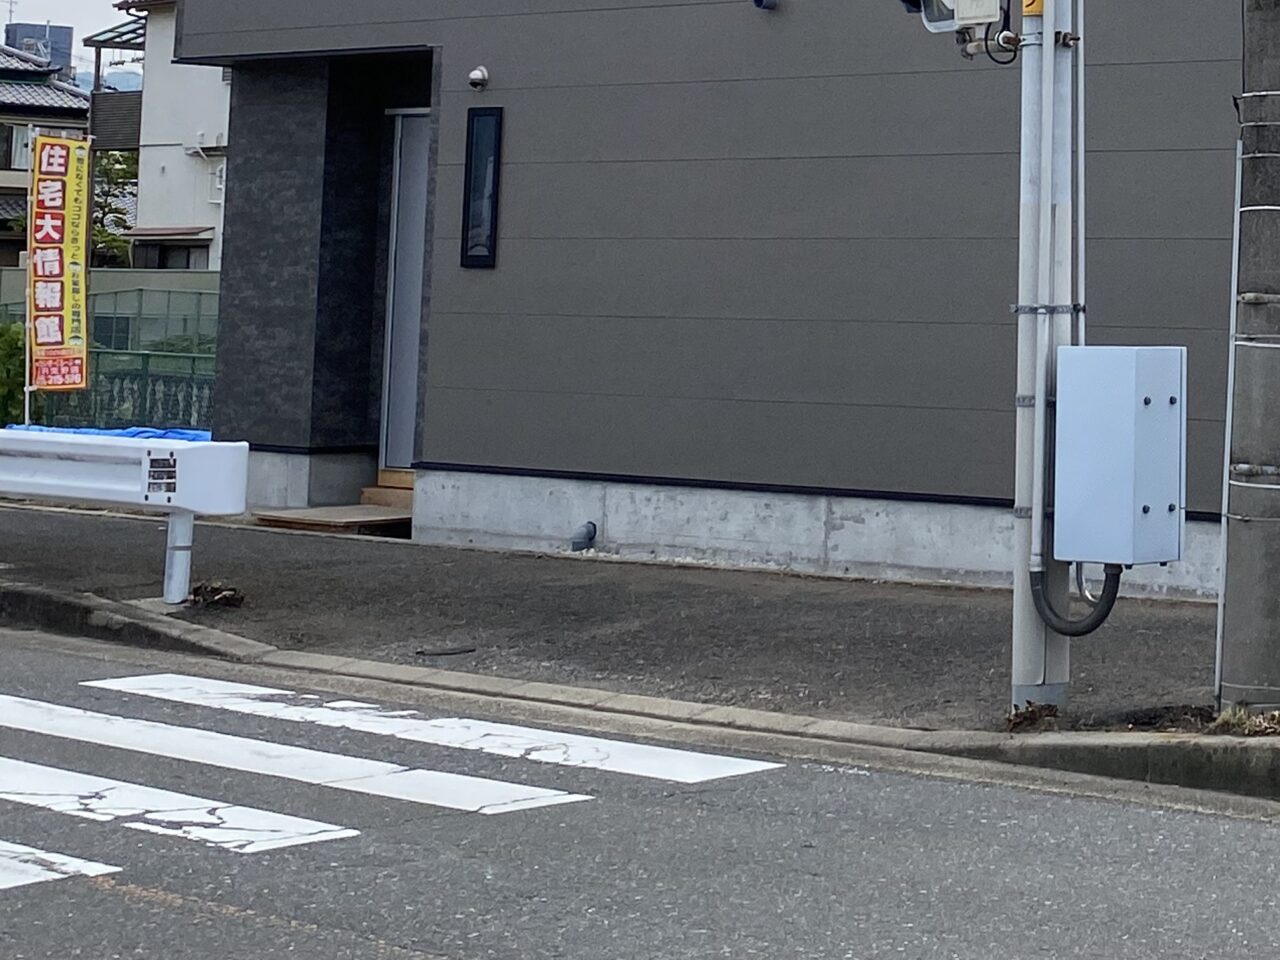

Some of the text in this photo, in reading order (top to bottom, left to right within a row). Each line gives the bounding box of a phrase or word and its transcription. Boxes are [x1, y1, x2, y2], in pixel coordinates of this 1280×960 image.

[34, 144, 67, 343] 住宅大情報館
